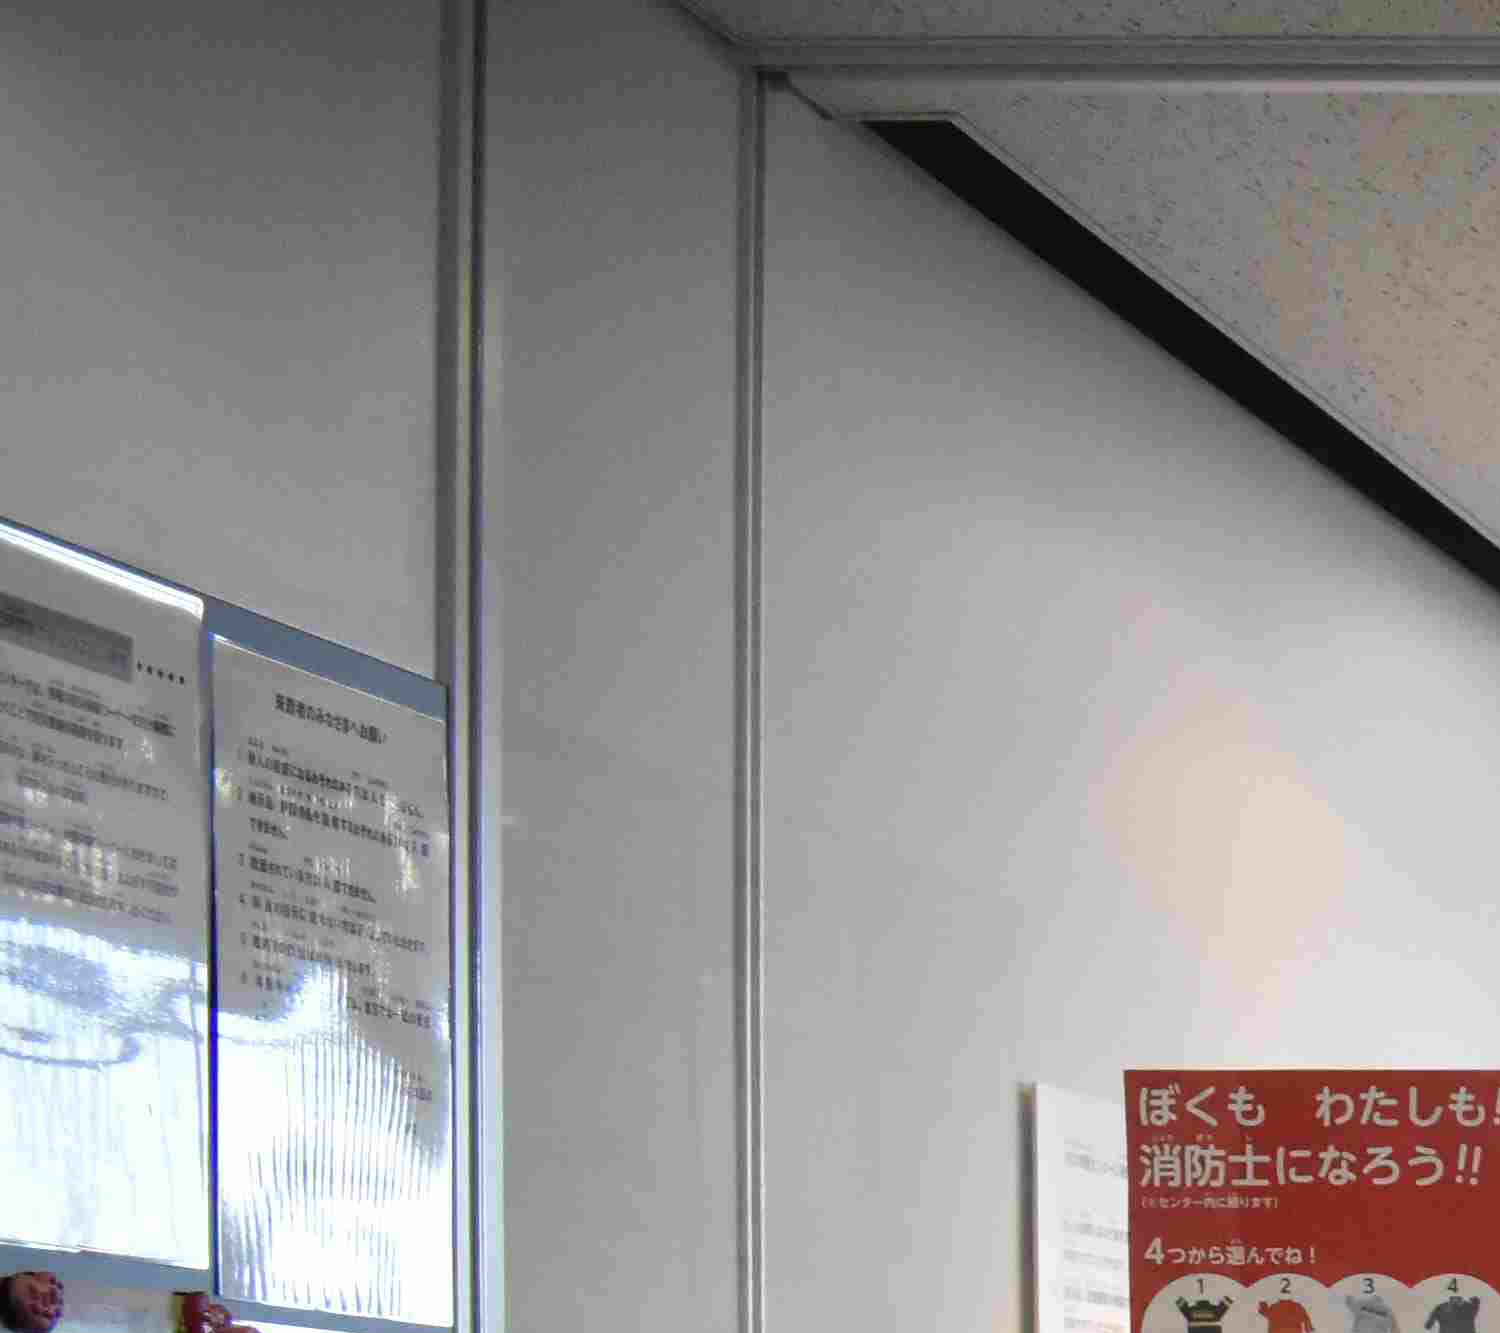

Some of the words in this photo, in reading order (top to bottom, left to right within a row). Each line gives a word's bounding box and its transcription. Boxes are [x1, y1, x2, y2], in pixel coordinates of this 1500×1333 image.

[1138, 1083, 1266, 1127] ぼくも
[1138, 1143, 1484, 1189] 消防士になろう!!
[1197, 1279, 1205, 1294] 1
[1280, 1279, 1292, 1294] 2
[1364, 1279, 1375, 1294] 3
[1447, 1278, 1460, 1294] 4
